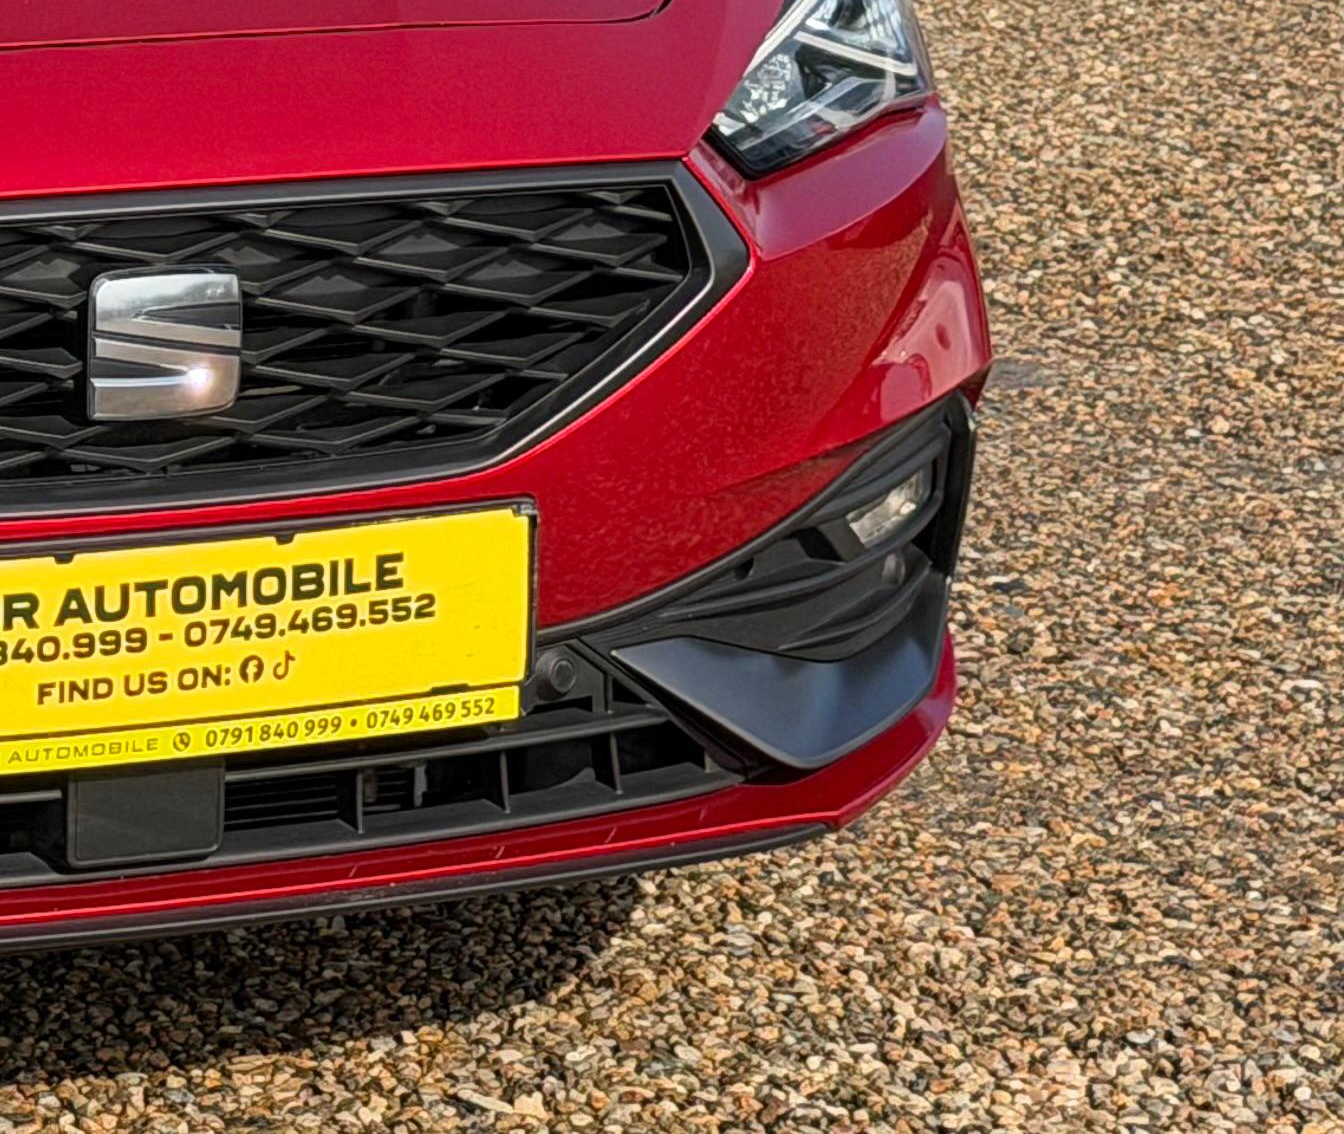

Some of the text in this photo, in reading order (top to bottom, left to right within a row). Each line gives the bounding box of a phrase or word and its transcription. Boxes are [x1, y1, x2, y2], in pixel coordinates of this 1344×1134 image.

[53, 552, 404, 627] AUTOMOBILE
[184, 592, 436, 647] 0749.469.552
[37, 664, 231, 705] FIND US ON:
[7, 738, 159, 765] AUTOMOBILE
